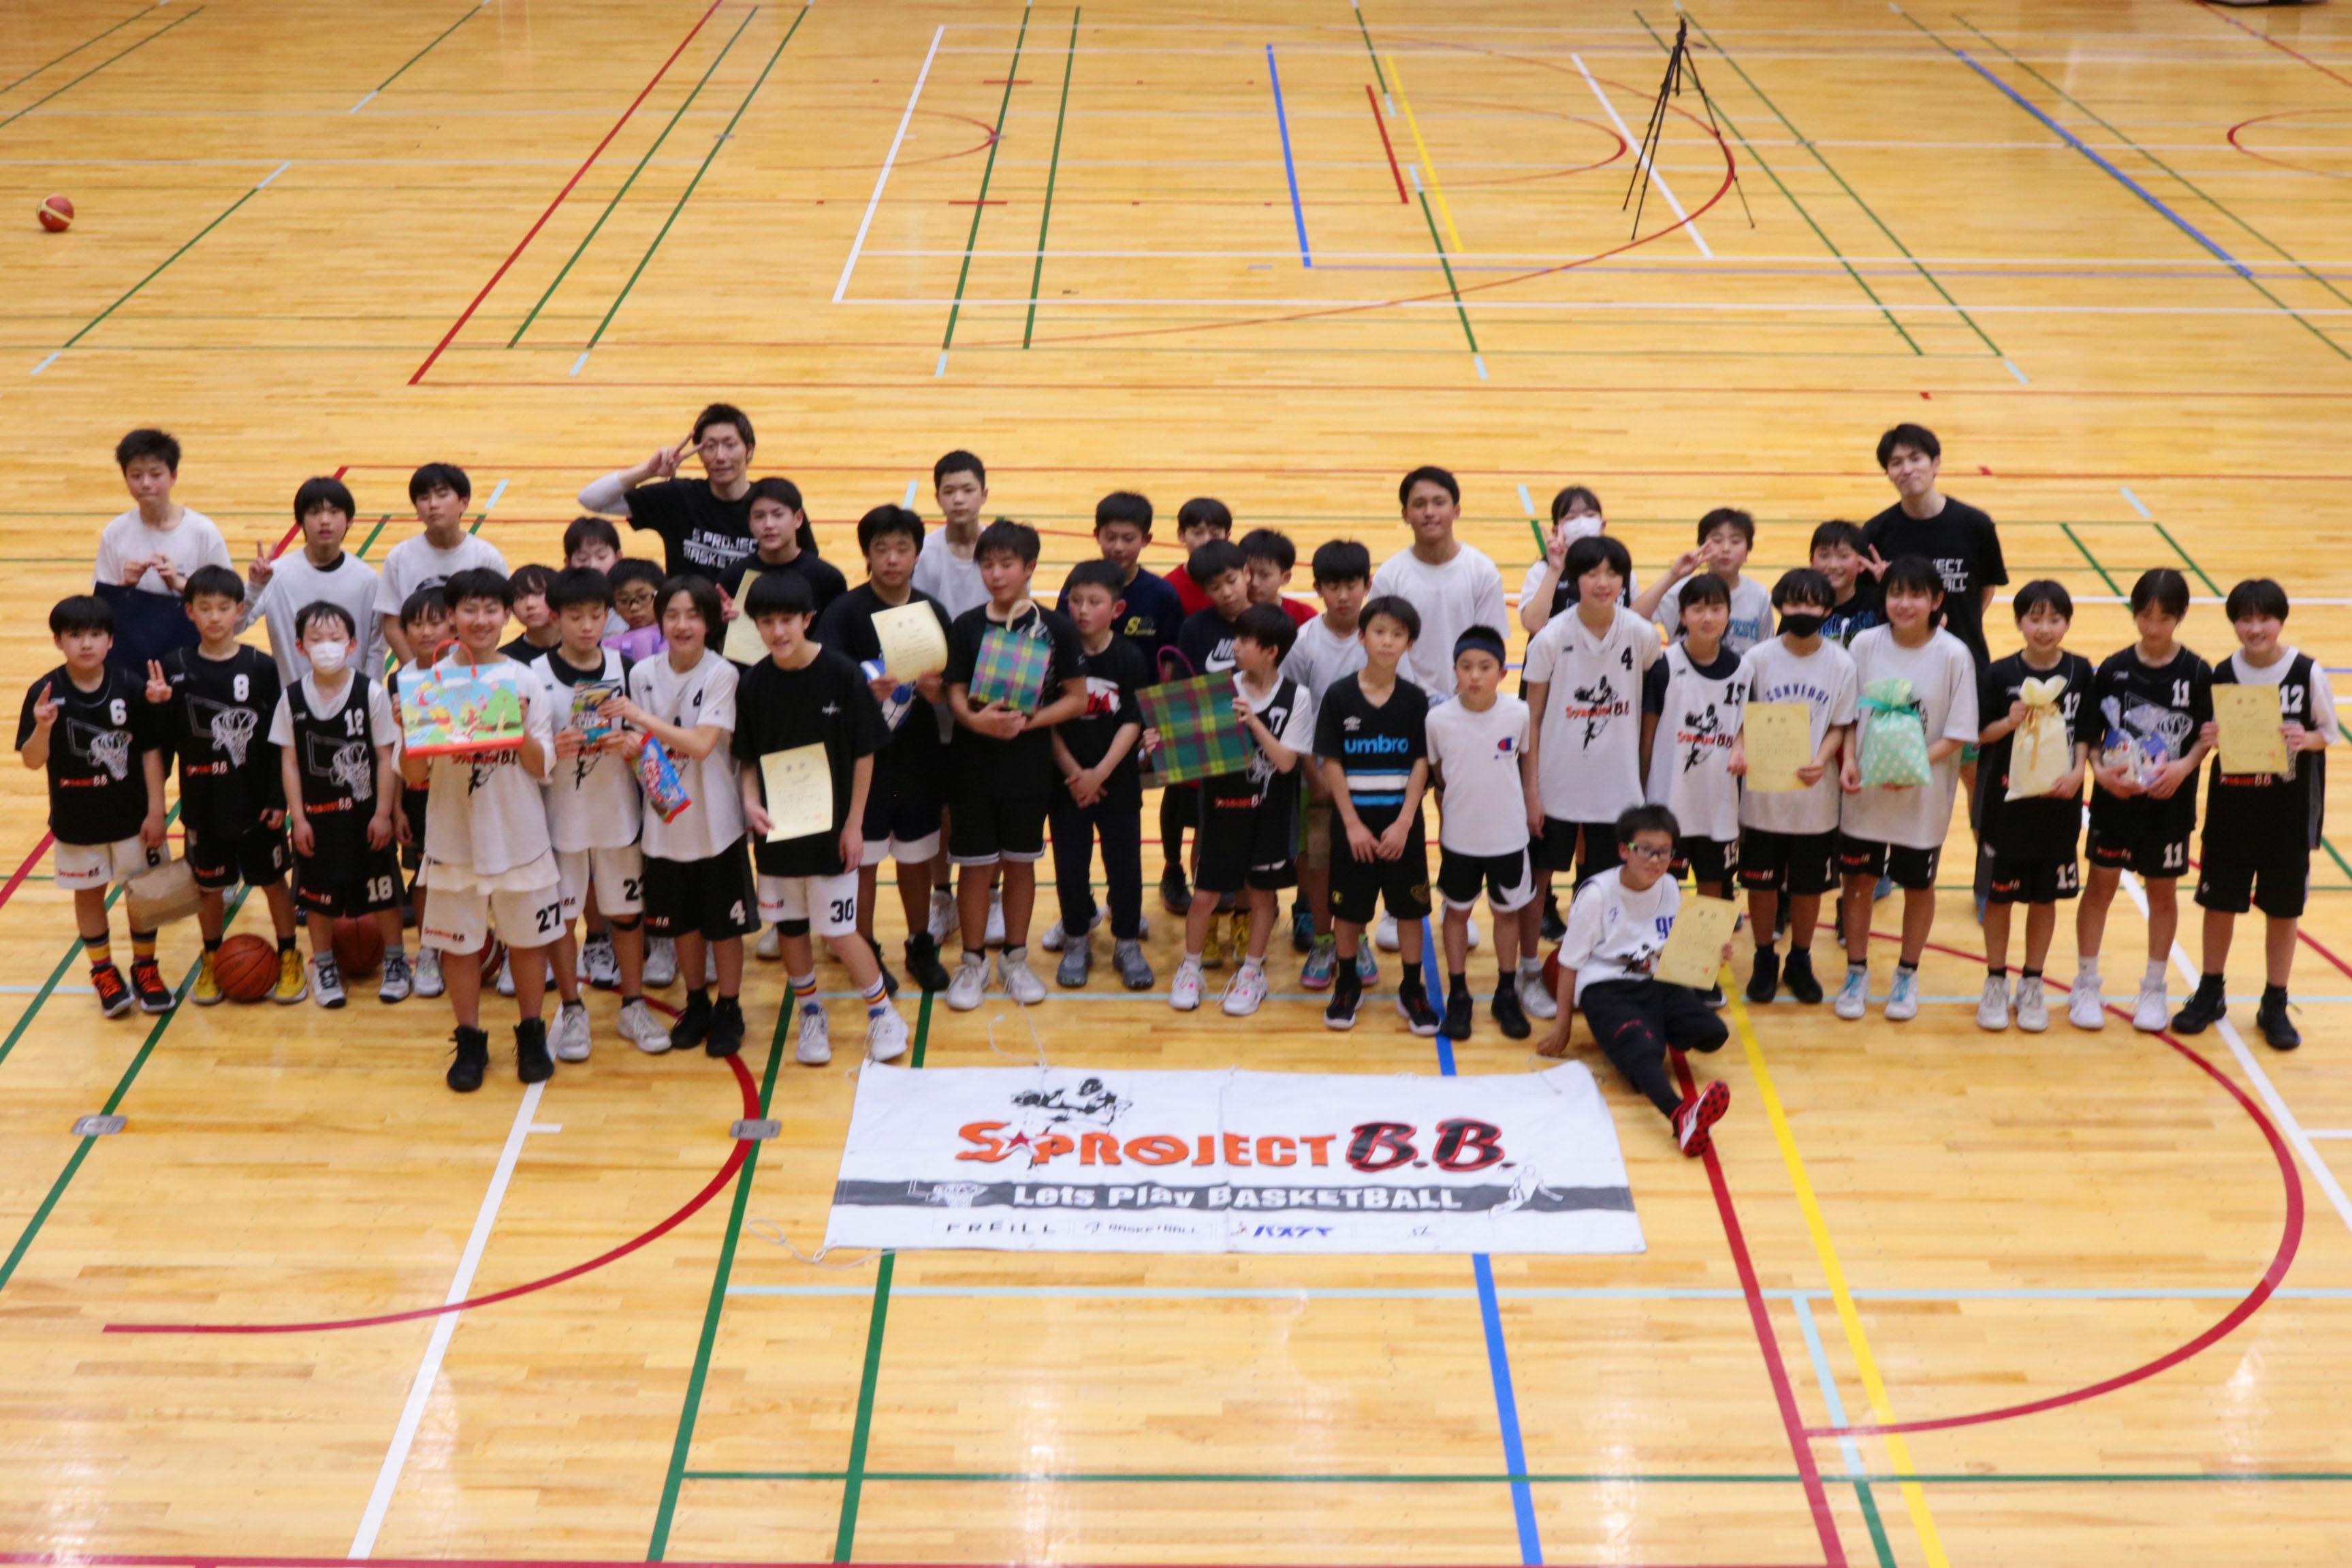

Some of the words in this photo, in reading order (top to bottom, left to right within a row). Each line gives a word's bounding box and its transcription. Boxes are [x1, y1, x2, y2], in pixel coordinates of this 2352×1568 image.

[1621, 645, 1633, 671] 4
[234, 673, 250, 702] 8
[2172, 678, 2191, 707] 11
[2279, 684, 2304, 714] 12
[109, 698, 127, 726] 6
[1344, 734, 1409, 755] umbro
[2163, 842, 2183, 869] 11
[366, 875, 393, 903] 18
[536, 903, 560, 933] 27
[730, 899, 746, 925] 4
[830, 897, 854, 923] 30
[1107, 1185, 1194, 1208] Play
[1207, 1186, 1463, 1210] BASKETBALL
